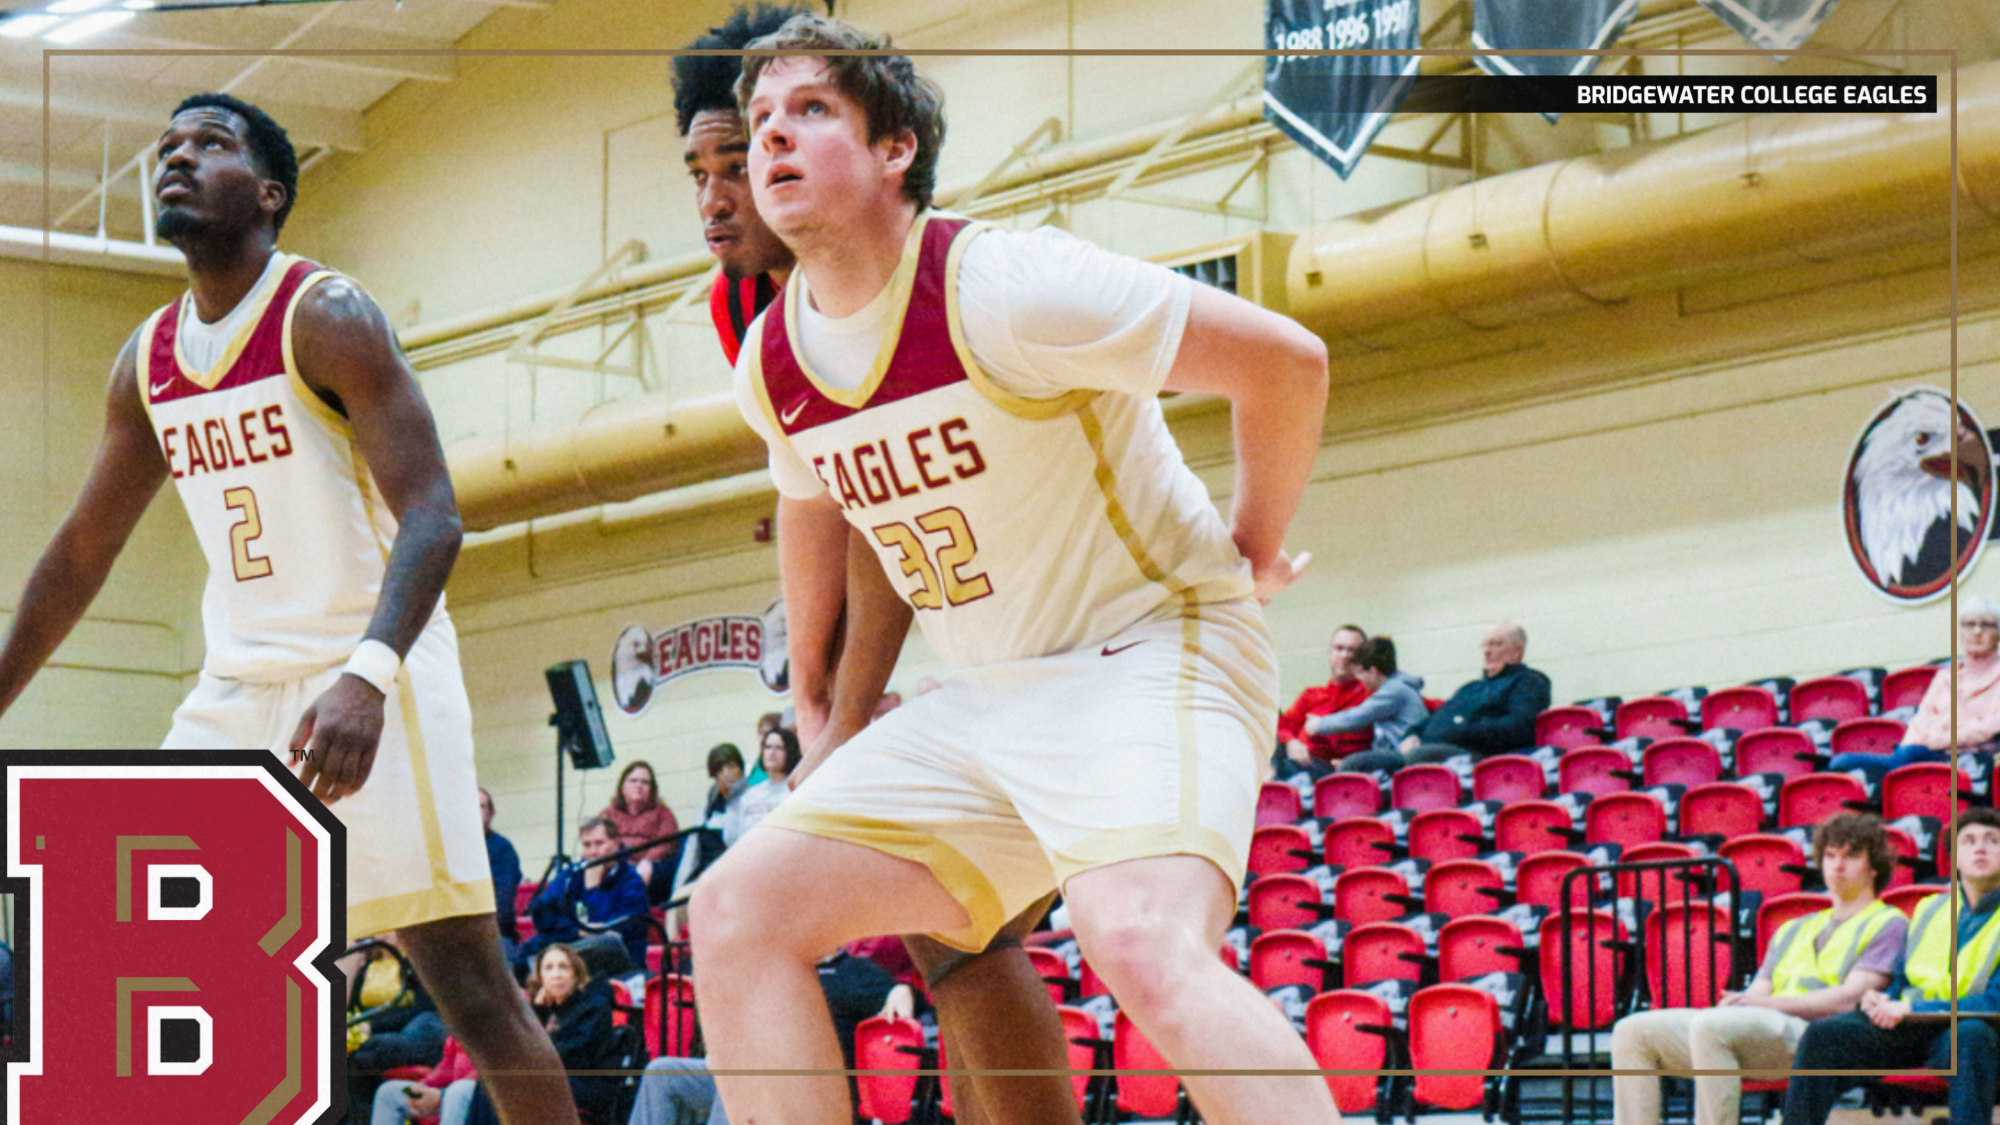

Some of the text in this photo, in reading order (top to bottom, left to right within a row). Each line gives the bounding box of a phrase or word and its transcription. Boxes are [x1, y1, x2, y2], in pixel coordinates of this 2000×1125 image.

[1275, 25, 1324, 64] 1988
[1326, 11, 1370, 51] 1996
[162, 403, 294, 480] EAGLES
[223, 486, 274, 582] 2
[871, 506, 995, 611] 32
[658, 622, 762, 677] EAGLES
